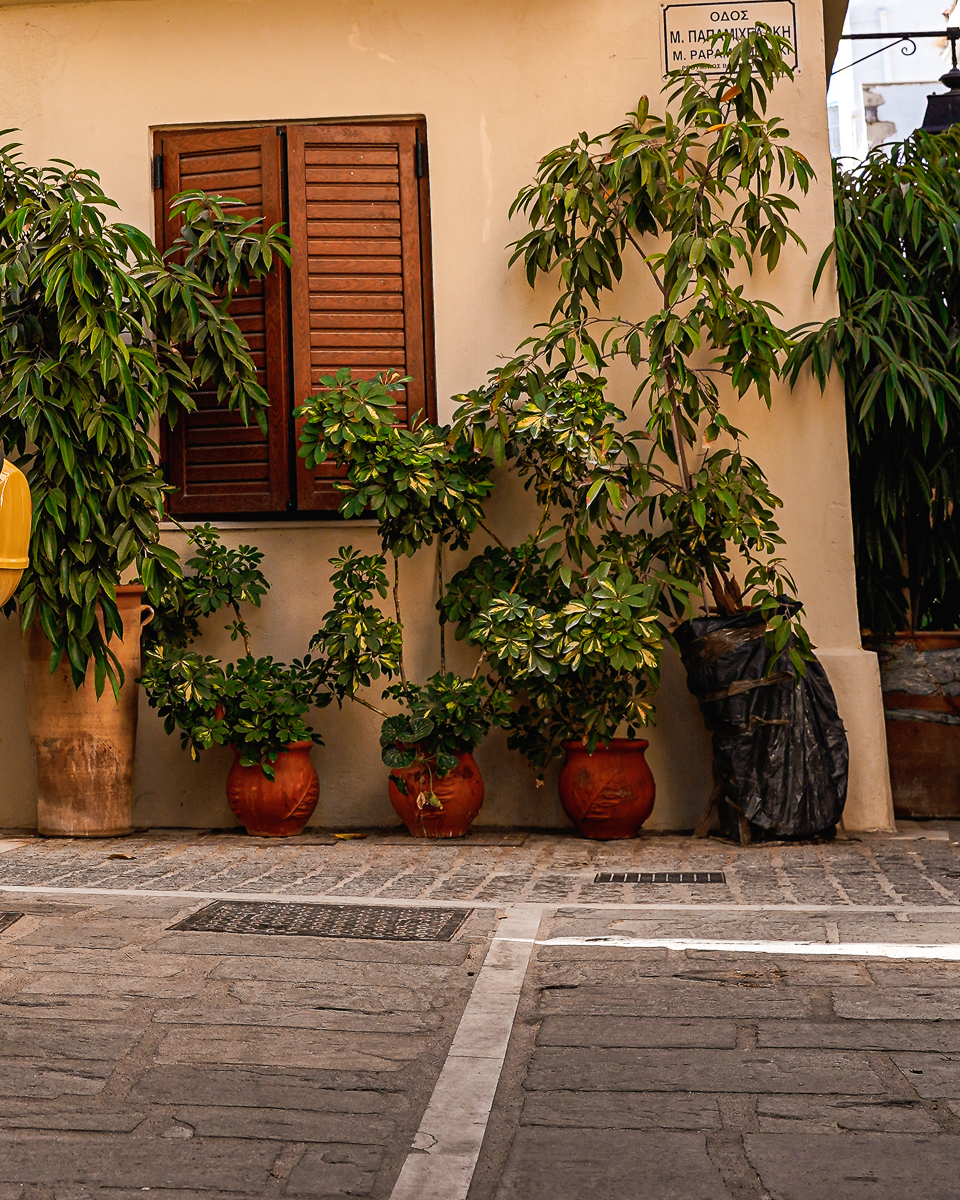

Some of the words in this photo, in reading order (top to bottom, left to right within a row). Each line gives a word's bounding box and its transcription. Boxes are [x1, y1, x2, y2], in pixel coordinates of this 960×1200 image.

[710, 10, 748, 22] ΟΔΟΣ
[670, 30, 684, 43] Μ.
[673, 51, 686, 61] M.
